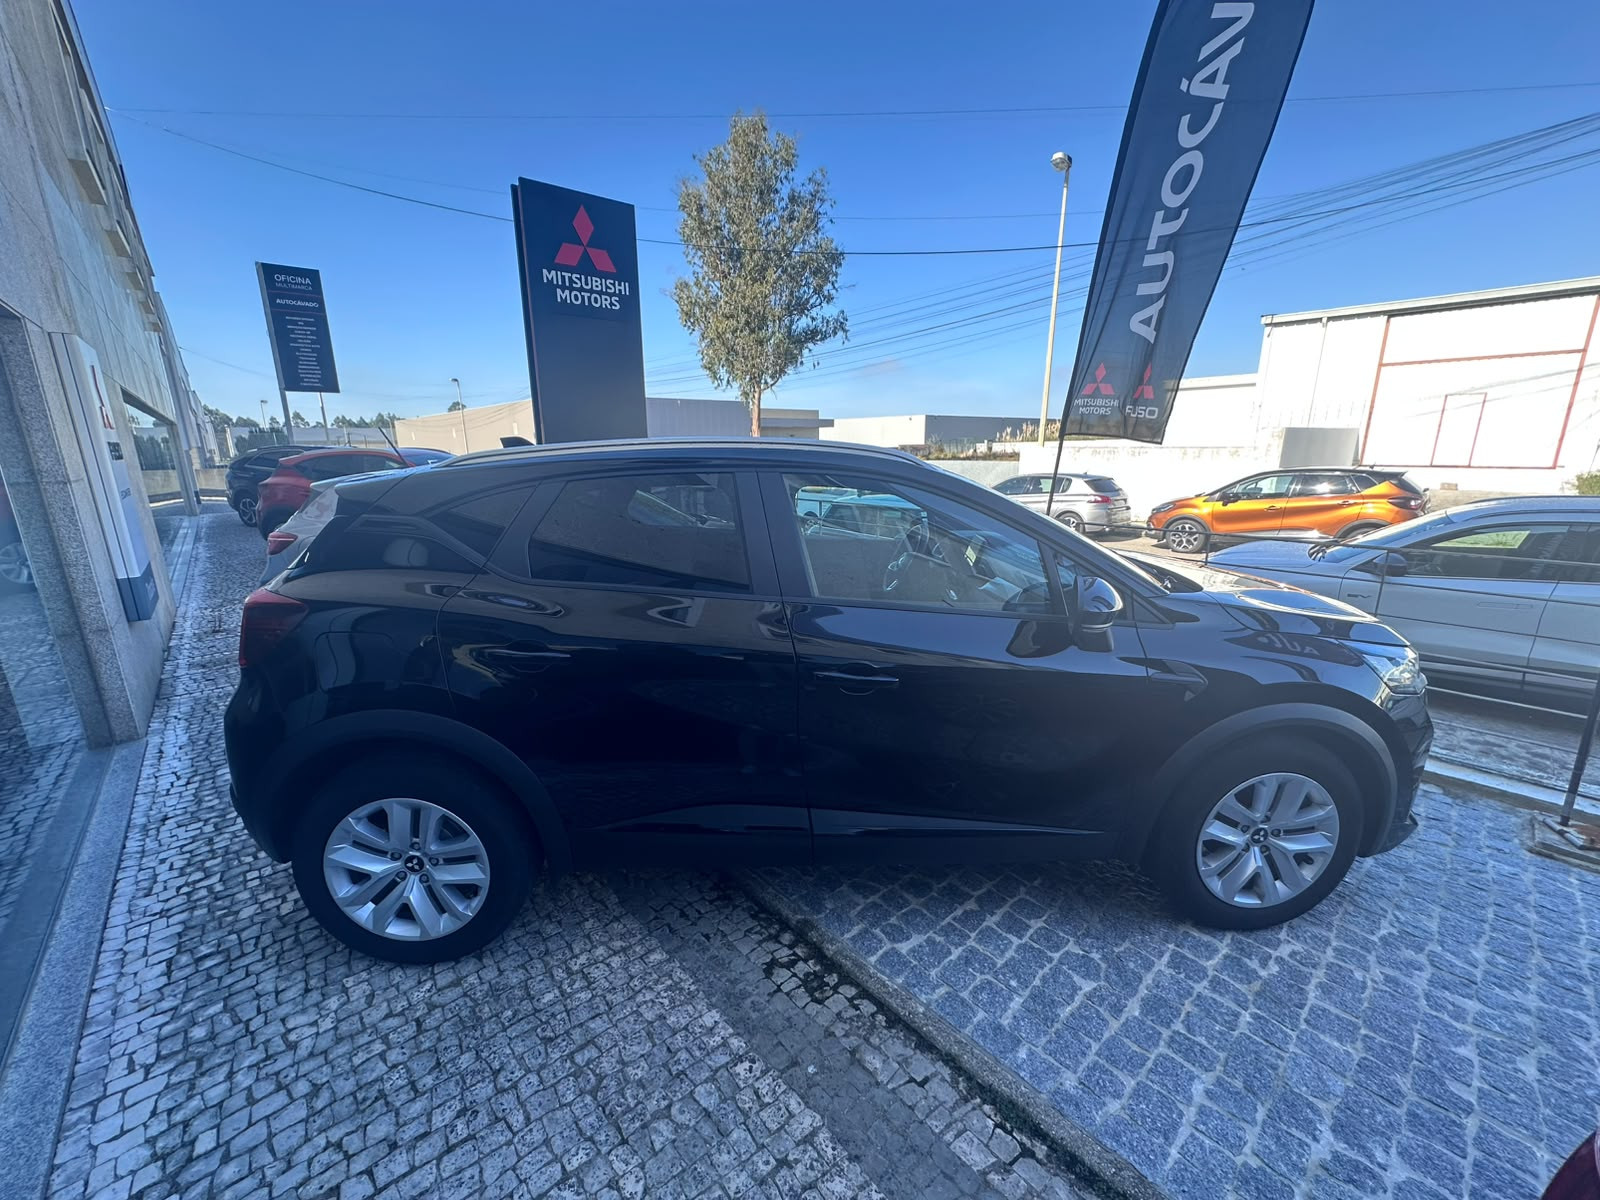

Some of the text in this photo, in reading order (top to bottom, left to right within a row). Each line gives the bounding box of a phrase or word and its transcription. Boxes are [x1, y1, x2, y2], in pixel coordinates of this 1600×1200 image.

[274, 274, 312, 285] OFICINA
[542, 268, 630, 295] MITSUBISHI
[556, 288, 621, 310] MOTORS
[1073, 398, 1119, 408] MITSUBISHI
[1079, 405, 1112, 416] MOTORS
[1125, 405, 1159, 419] FUSO
